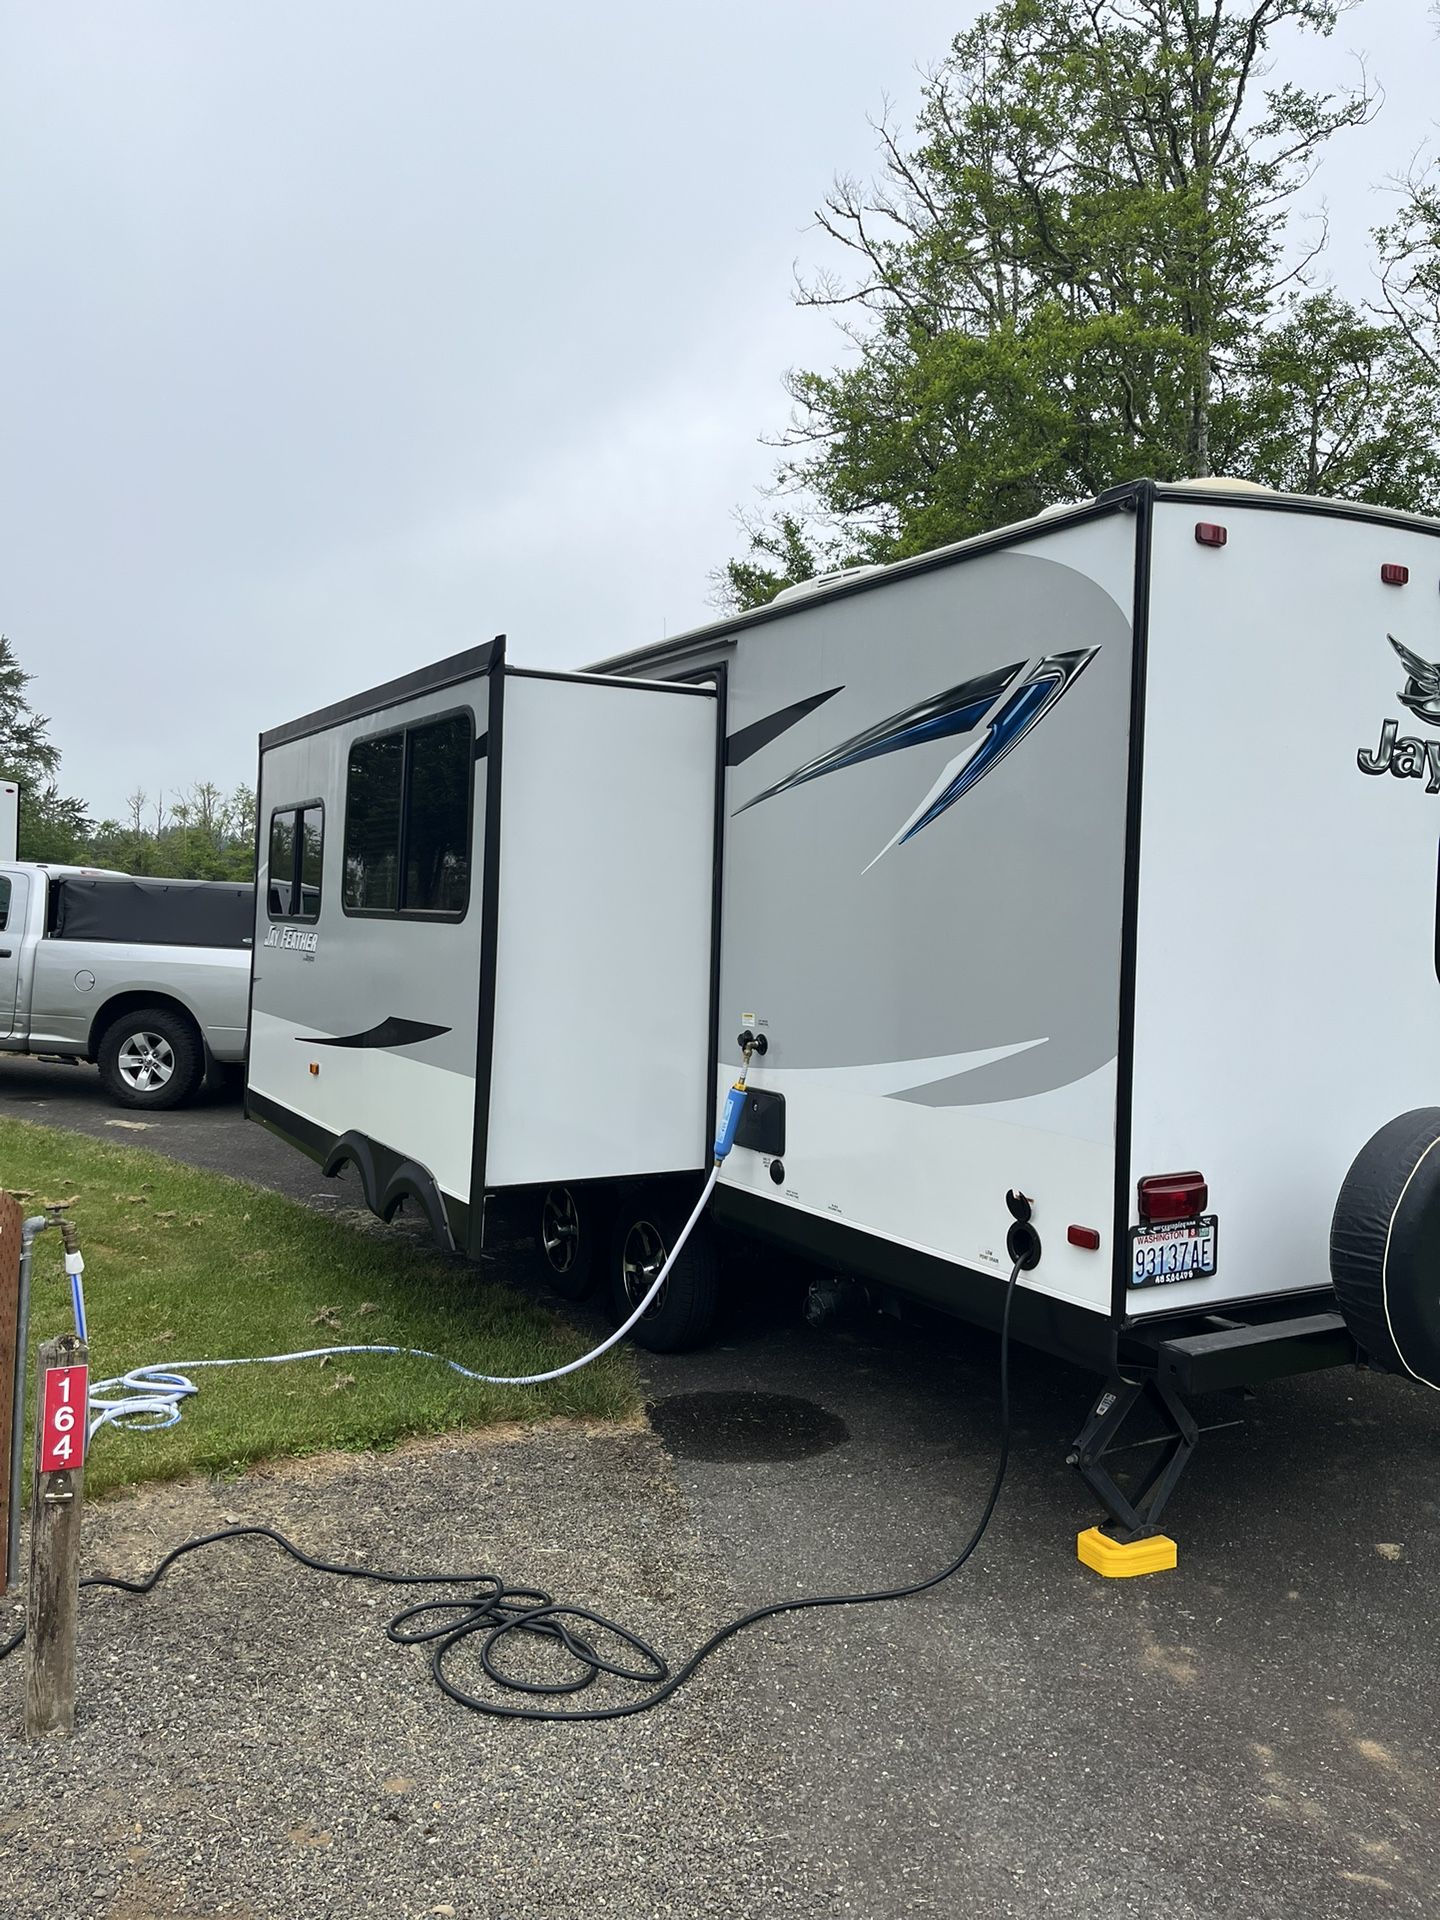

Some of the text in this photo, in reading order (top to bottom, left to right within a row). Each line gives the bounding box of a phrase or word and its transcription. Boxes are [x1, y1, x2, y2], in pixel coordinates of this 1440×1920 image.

[263, 925, 319, 953] JAY FEATHER
[1137, 1230, 1184, 1245] WASHINGTON
[1135, 1238, 1211, 1277] 93137AE
[52, 1377, 75, 1460] 164
